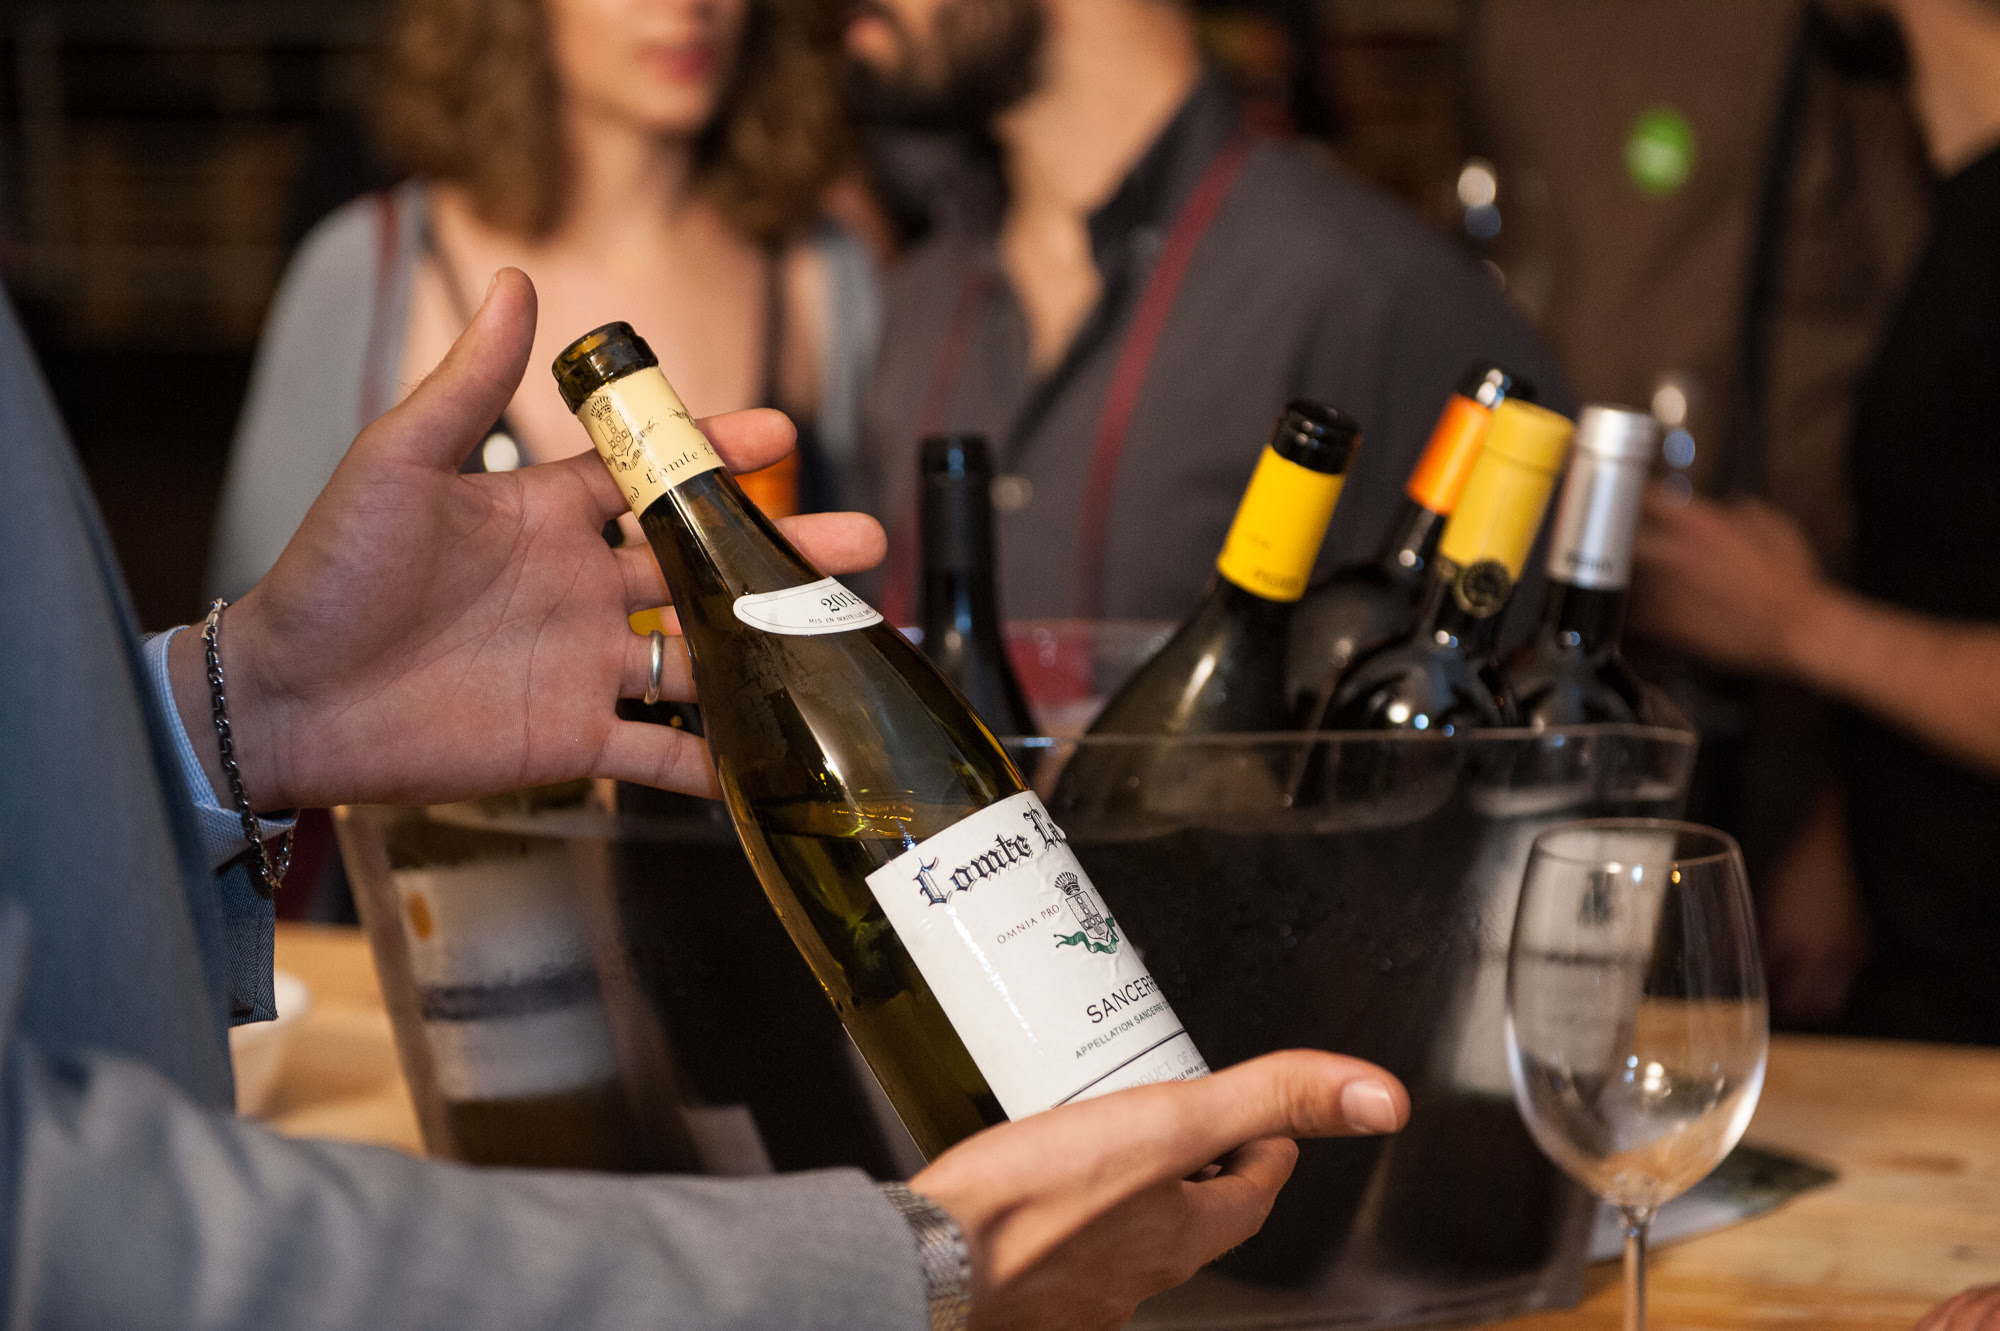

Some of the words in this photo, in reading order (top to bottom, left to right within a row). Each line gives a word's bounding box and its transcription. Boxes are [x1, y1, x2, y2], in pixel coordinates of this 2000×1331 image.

[645, 451, 699, 484] Comte
[836, 611, 865, 622] BOUTEILLE
[911, 832, 1034, 907] Comte
[1022, 801, 1067, 853] La
[997, 916, 1039, 945] OMNIA
[1040, 903, 1061, 921] PRO
[1086, 974, 1161, 1024] SANCERR
[1075, 1018, 1135, 1059] APPELLATION
[1133, 1002, 1165, 1025] SANCERRE
[1122, 1060, 1172, 1090] ODUCT
